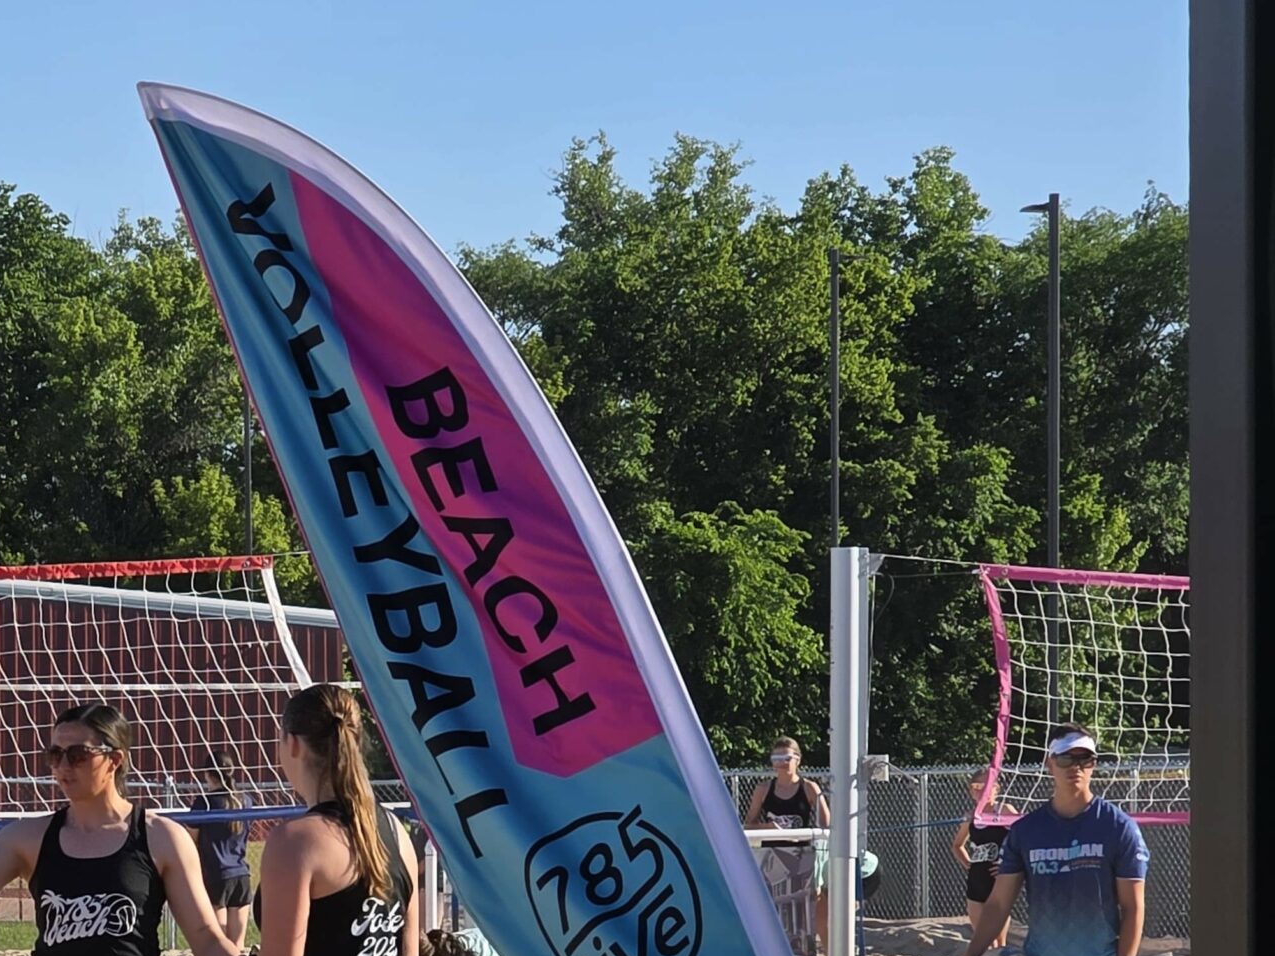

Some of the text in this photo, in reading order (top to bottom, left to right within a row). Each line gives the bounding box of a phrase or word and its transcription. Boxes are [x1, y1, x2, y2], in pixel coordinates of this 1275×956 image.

[227, 181, 512, 858] VOLLEYBALL
[385, 366, 596, 738] BEACH
[1029, 839, 1104, 863] IRONMAN
[1030, 861, 1059, 876] 70.3
[536, 804, 664, 940] 785
[47, 906, 111, 946] beach
[62, 893, 107, 924] 785
